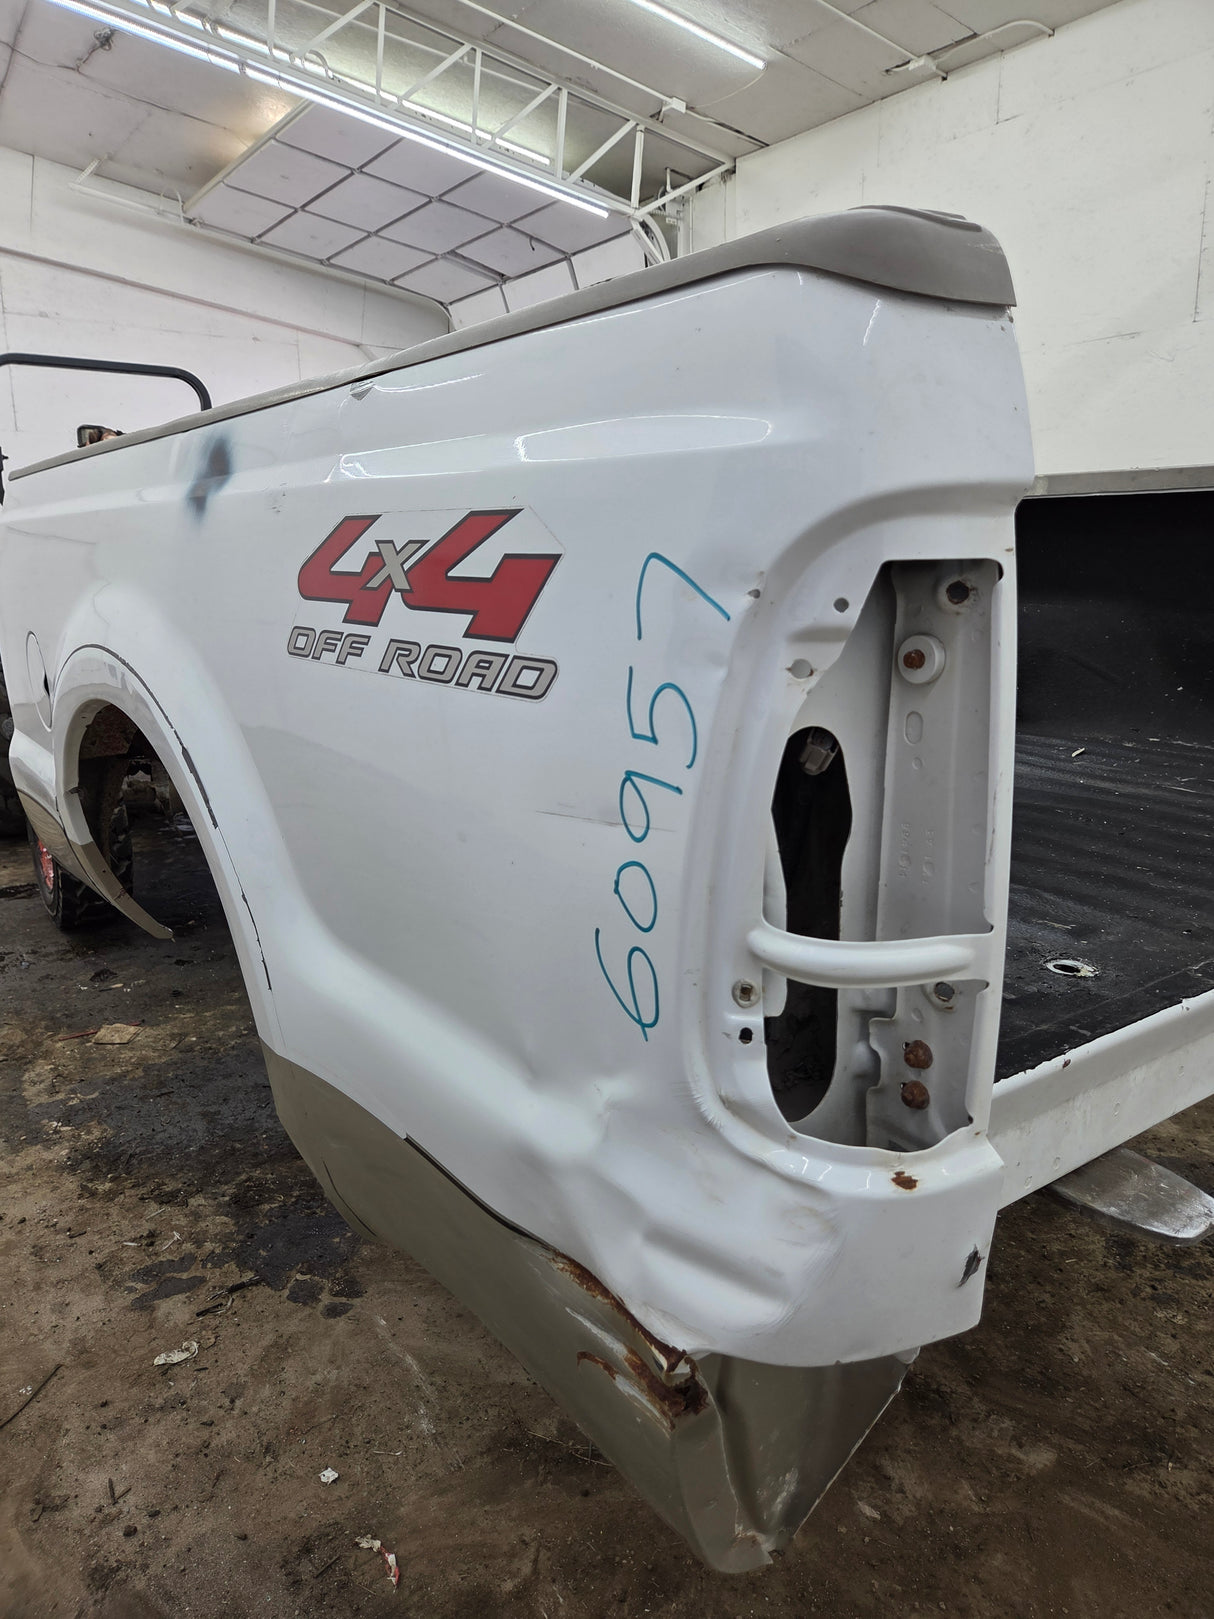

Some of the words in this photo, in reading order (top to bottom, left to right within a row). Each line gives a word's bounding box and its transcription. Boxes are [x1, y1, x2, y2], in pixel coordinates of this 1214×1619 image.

[287, 625, 371, 665] OFF
[378, 638, 559, 700] ROAD
[595, 552, 730, 1042] 60957
